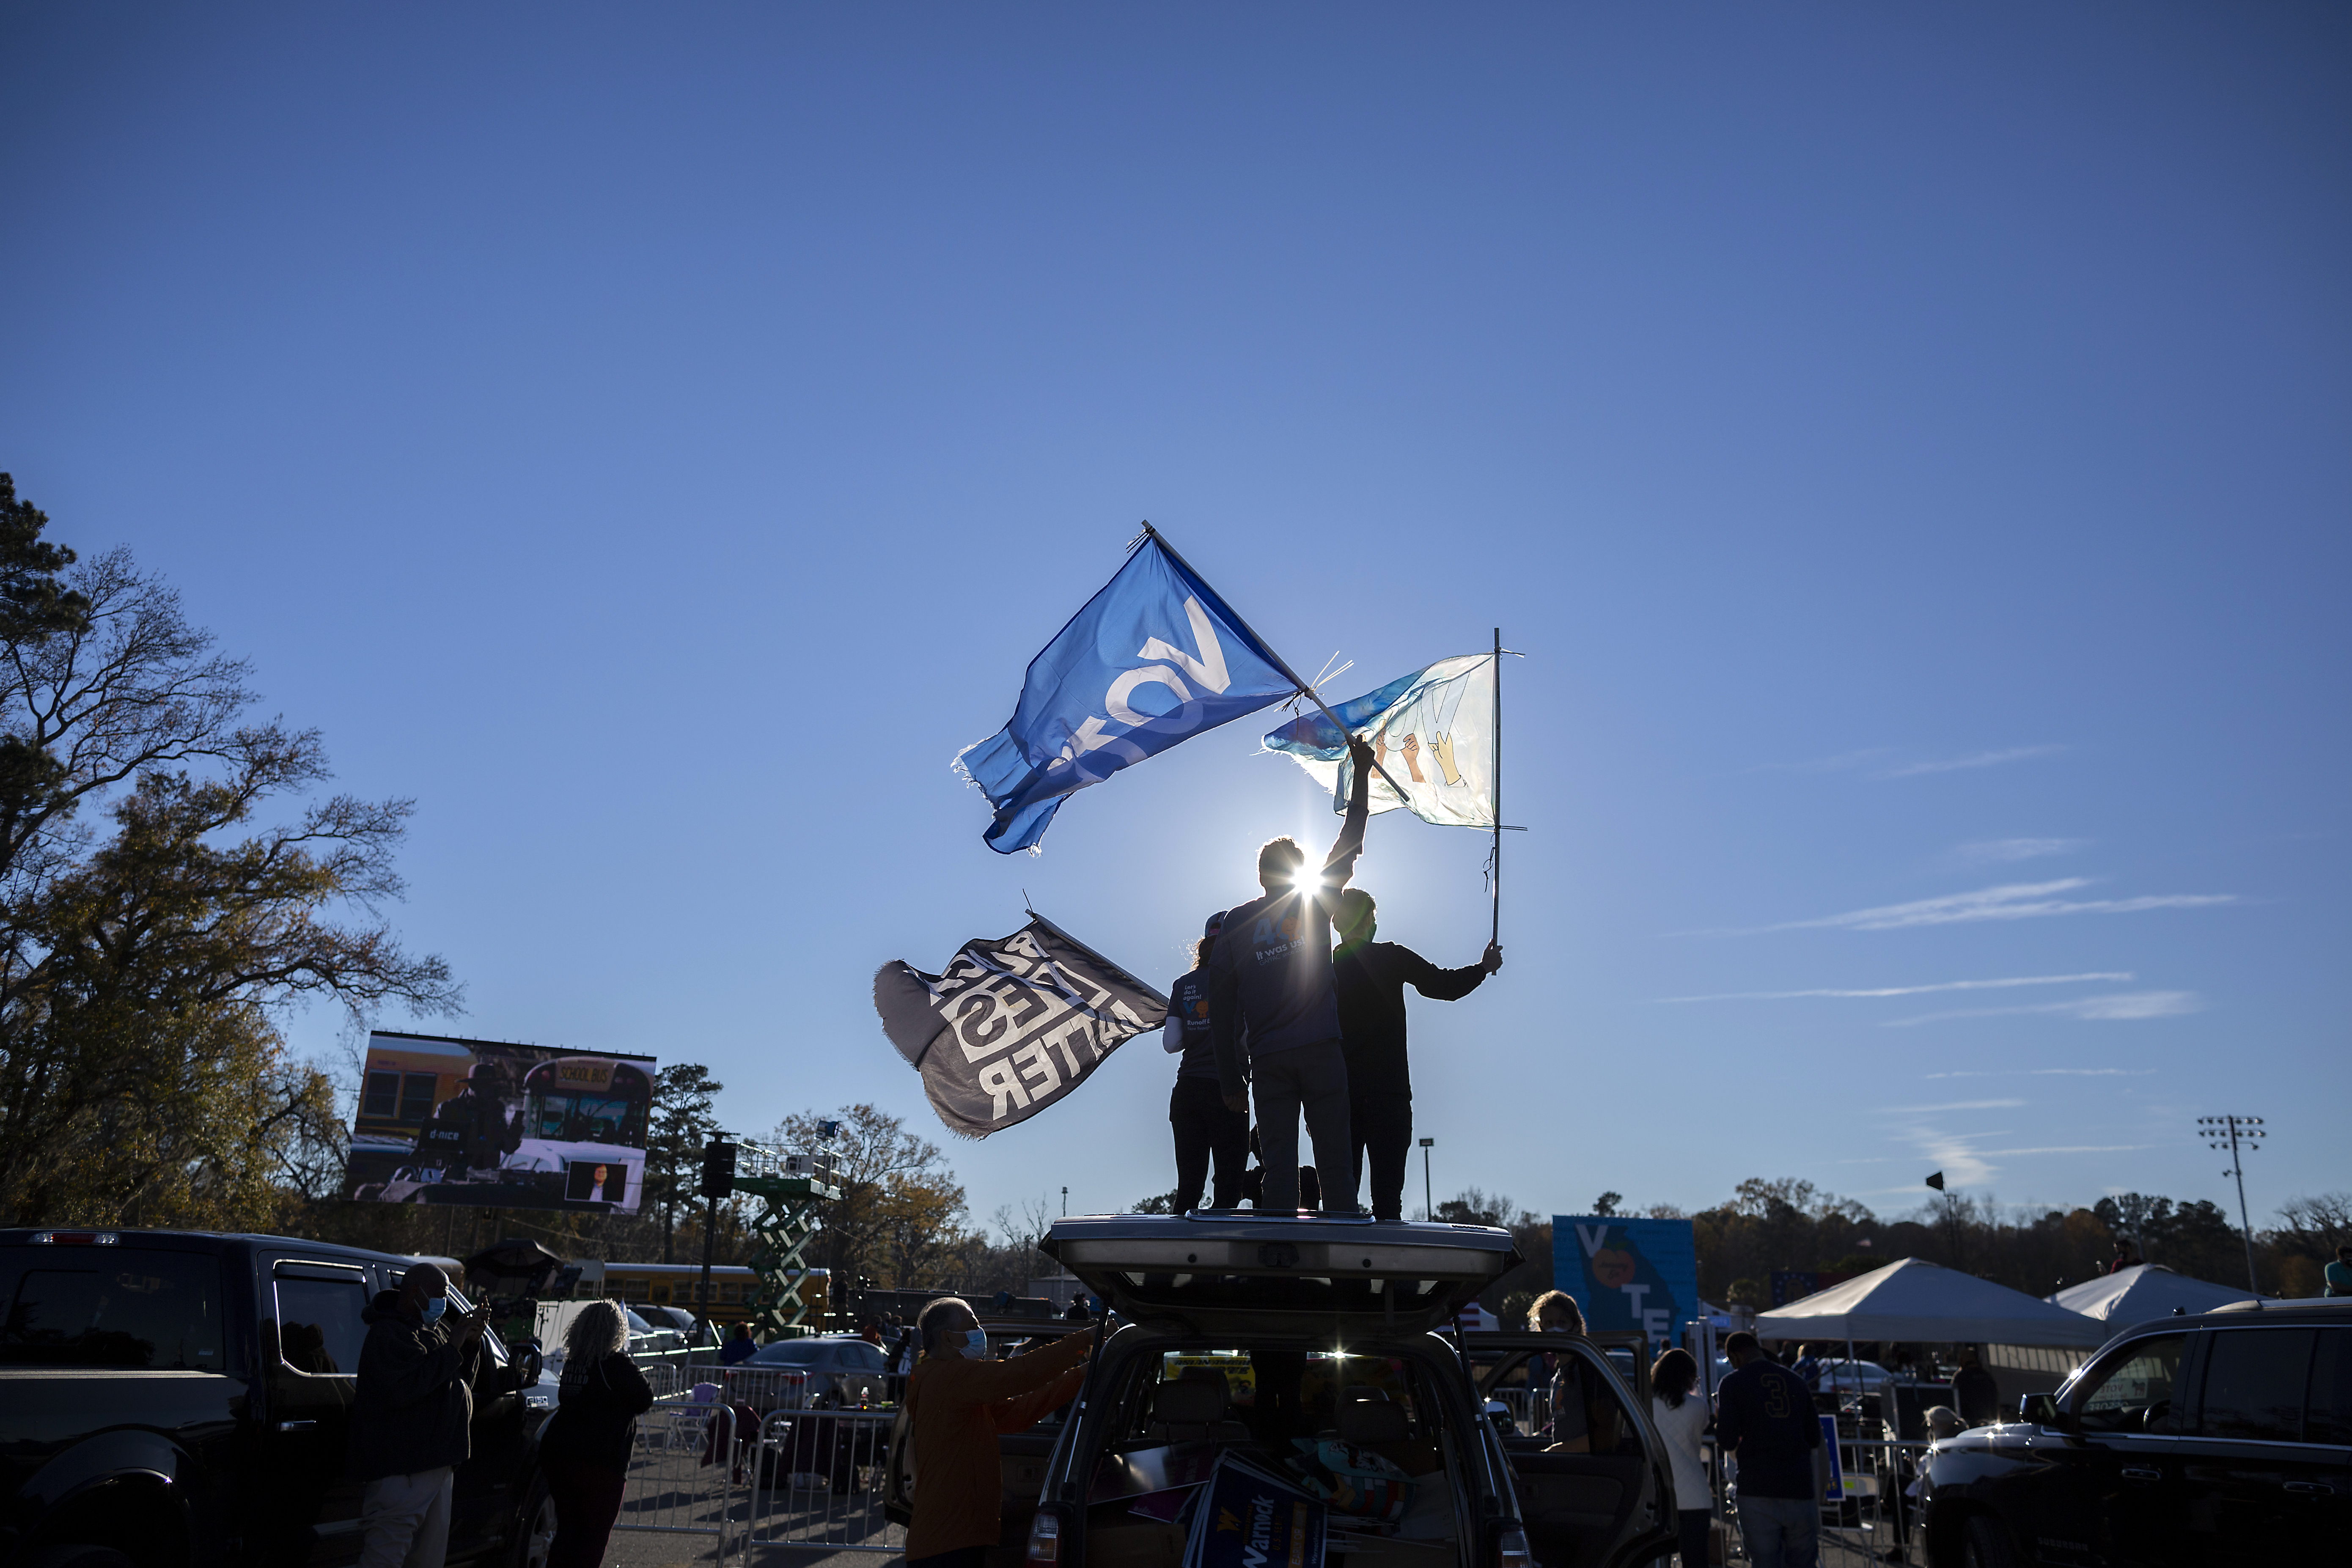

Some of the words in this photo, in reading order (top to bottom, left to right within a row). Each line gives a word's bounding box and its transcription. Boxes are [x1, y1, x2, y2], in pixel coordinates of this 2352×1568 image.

[1256, 951, 1264, 961] It
[1264, 944, 1288, 957] was
[1290, 935, 1306, 948] us!
[1259, 954, 1281, 966] GAPPAC
[1575, 1224, 1671, 1344] VTE
[1760, 1373, 1791, 1417] 3
[1242, 1494, 1275, 1568] Warnock
